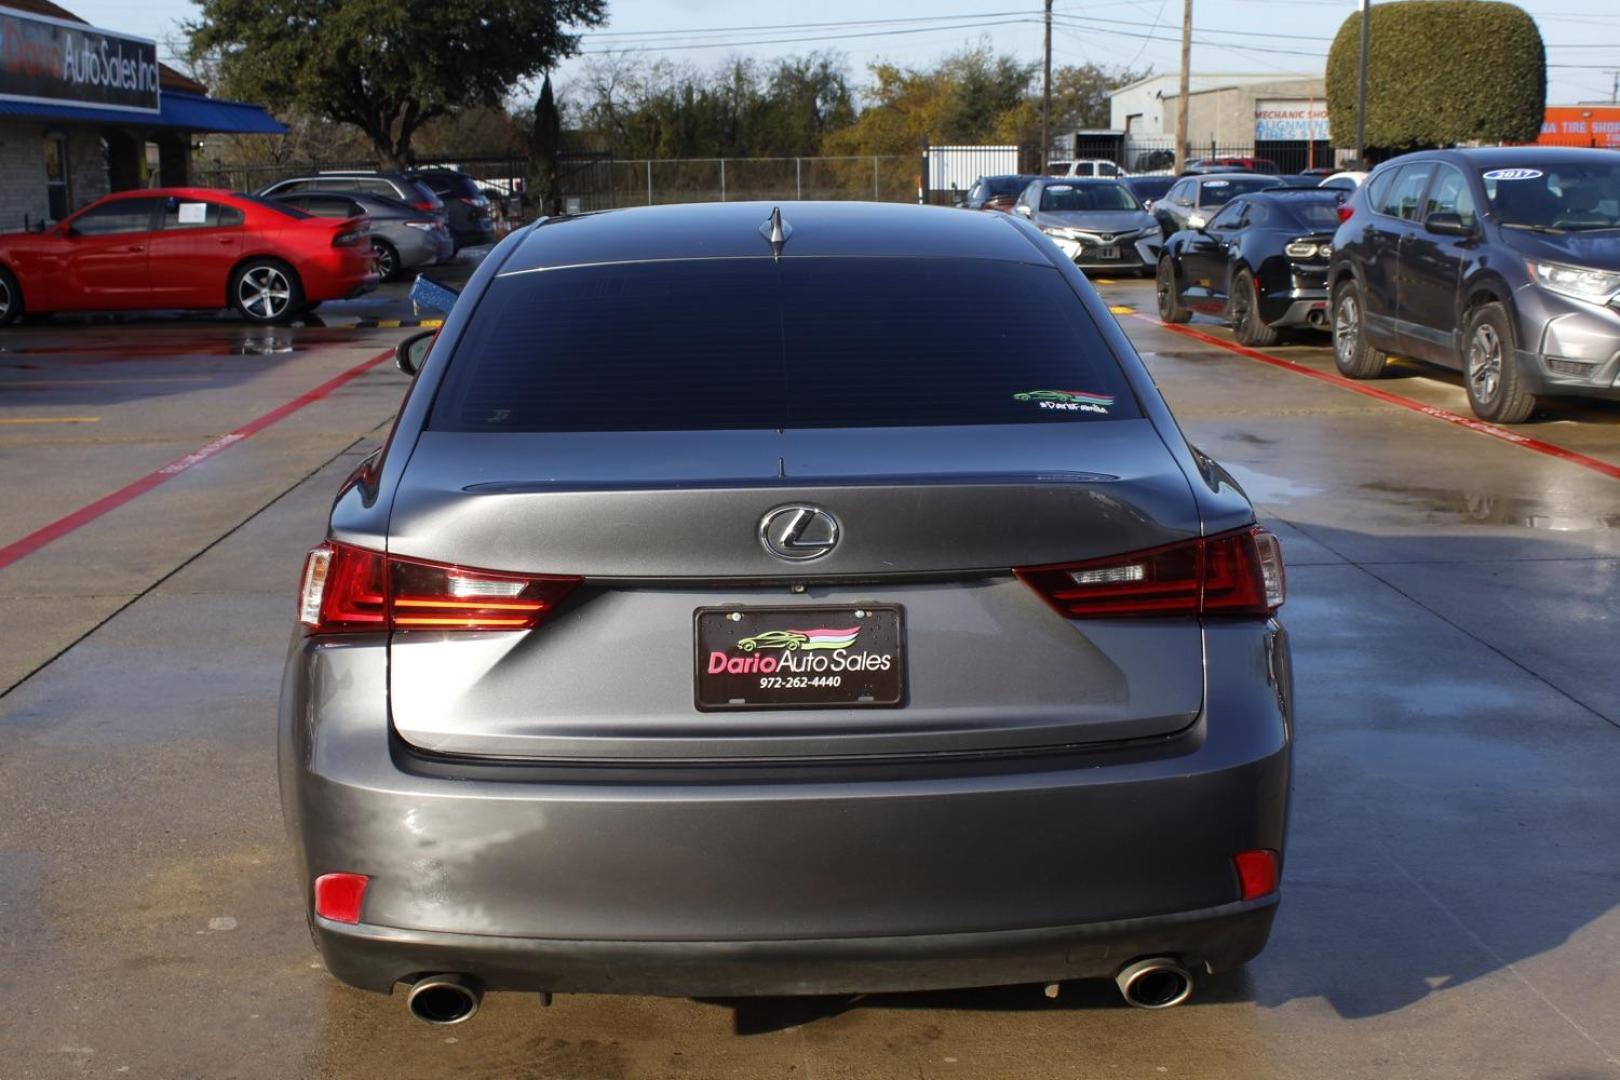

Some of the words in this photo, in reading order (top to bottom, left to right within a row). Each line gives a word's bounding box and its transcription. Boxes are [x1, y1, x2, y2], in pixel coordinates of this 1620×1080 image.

[1255, 110, 1304, 119] MECHANIC
[1562, 121, 1587, 134] TIRE
[1497, 169, 1534, 179] 2017
[708, 651, 777, 675] Dario
[830, 648, 892, 673] Sales
[759, 676, 842, 689] 972-262-4440
